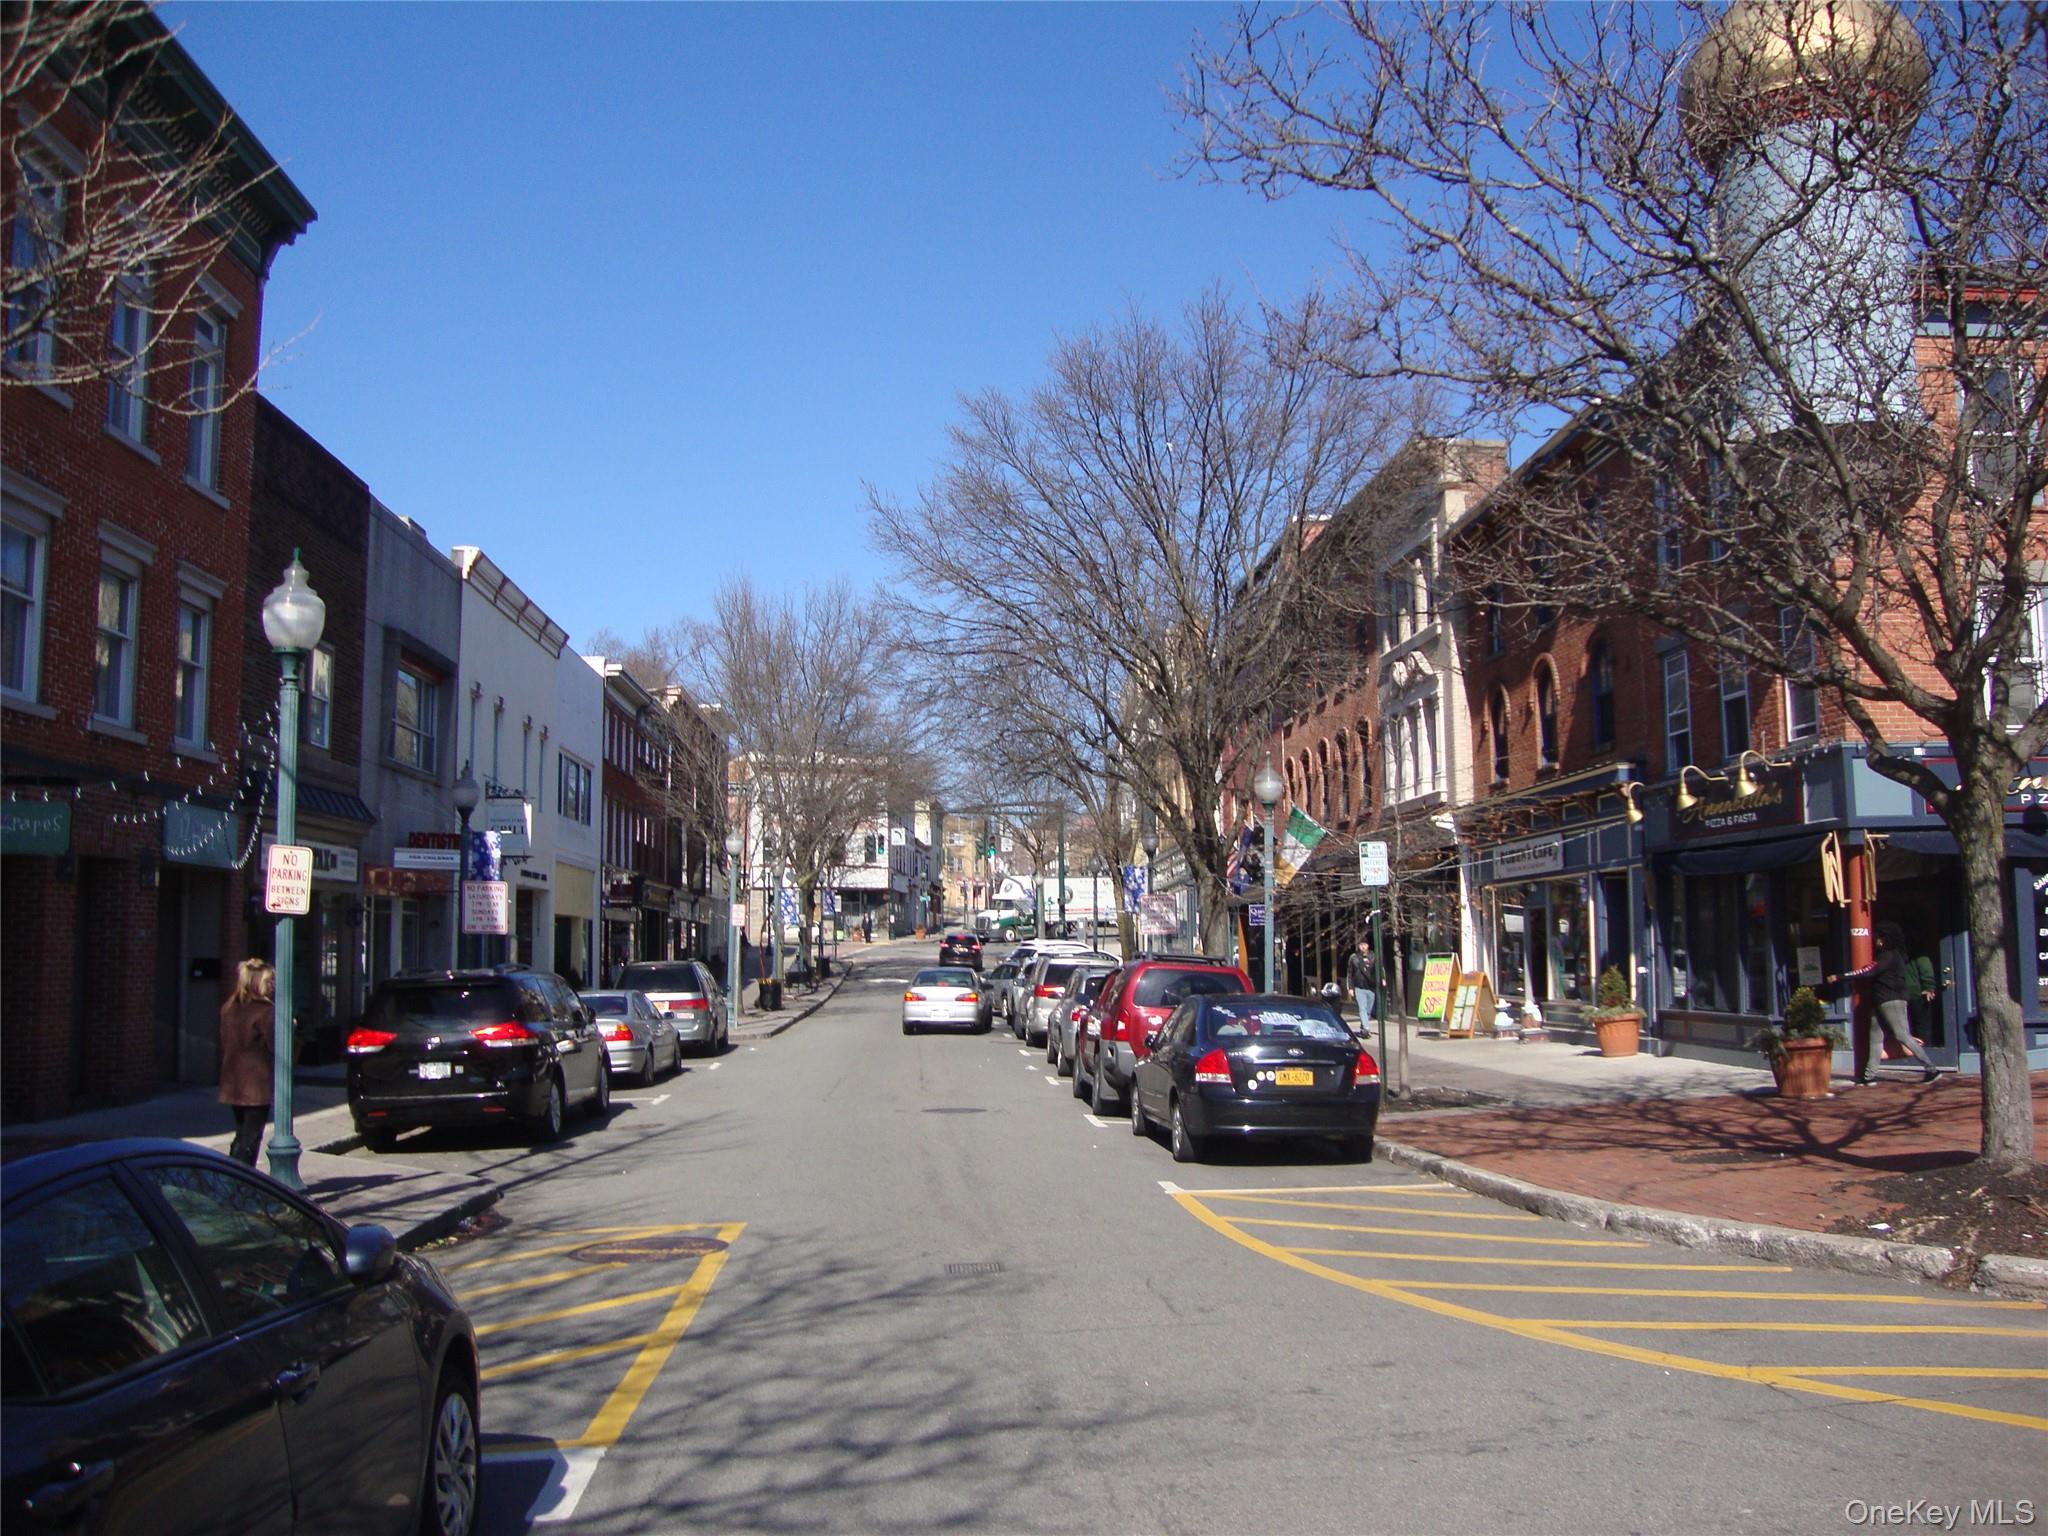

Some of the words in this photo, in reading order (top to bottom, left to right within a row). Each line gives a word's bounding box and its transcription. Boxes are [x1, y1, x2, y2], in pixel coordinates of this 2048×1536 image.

[1705, 818, 1726, 828] PIZZA
[1734, 813, 1758, 824] PASTA
[282, 854, 298, 866] NO
[271, 867, 307, 882] PARKING
[270, 885, 306, 896] BETWEEN
[276, 896, 300, 906] SIGNS
[1426, 963, 1450, 976] LUNCH
[1424, 981, 1447, 992] SPECIAL
